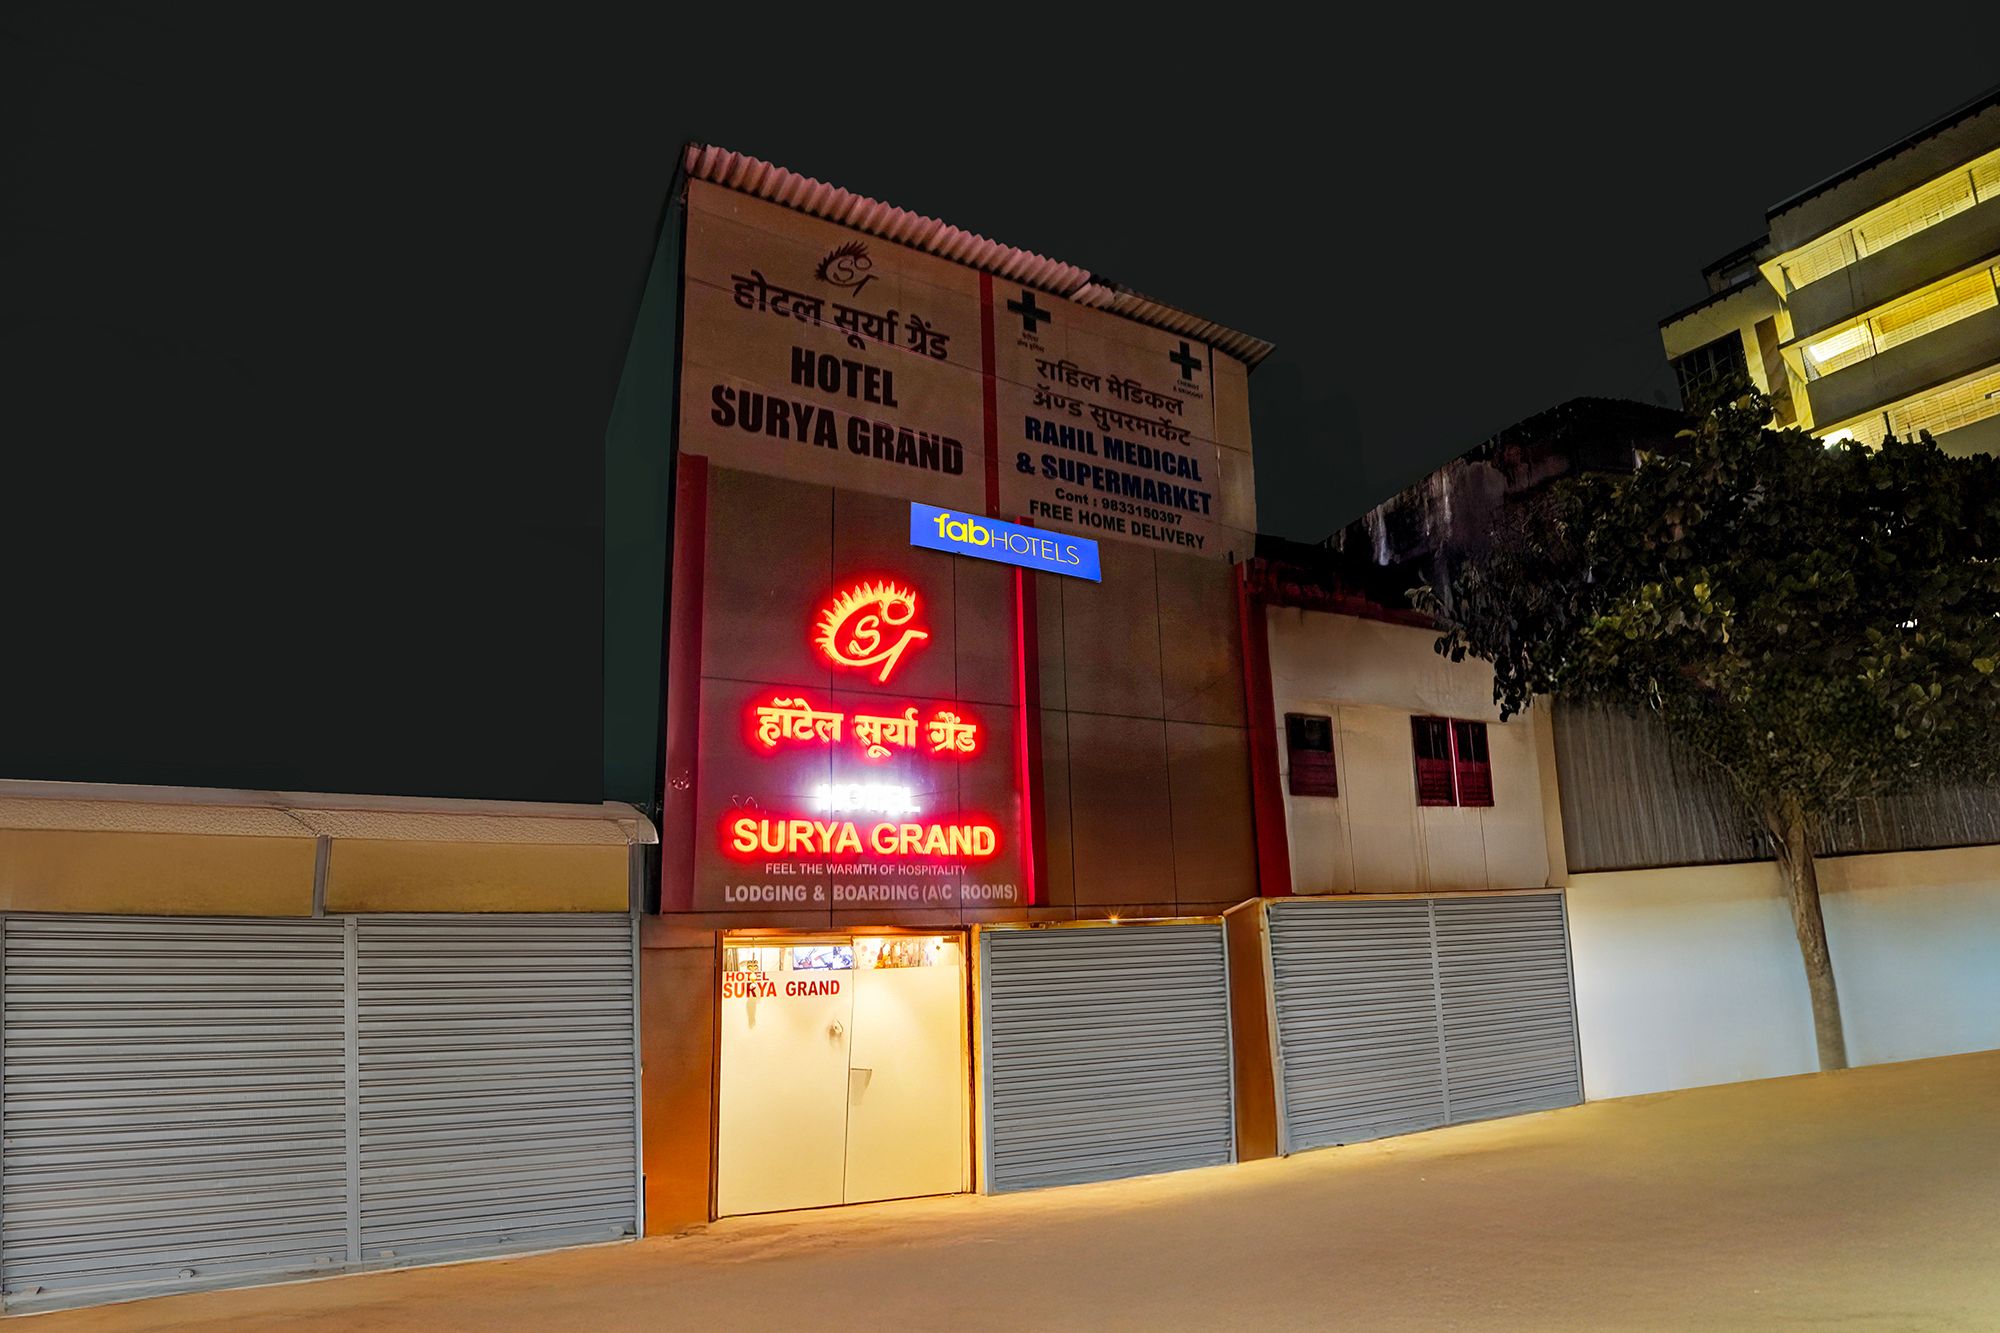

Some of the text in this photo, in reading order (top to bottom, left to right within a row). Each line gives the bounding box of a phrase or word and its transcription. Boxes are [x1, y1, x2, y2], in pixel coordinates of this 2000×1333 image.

[791, 346, 898, 408] HOTEL
[711, 384, 964, 476] SURYA GRAND
[1025, 416, 1202, 482] RAHIL MEDICAL
[1016, 452, 1212, 515] & SUPERMARKET
[1030, 499, 1205, 550] FREE HOME DELIVERY
[1055, 487, 1089, 507] Cont
[1102, 497, 1182, 525] 9833150397
[733, 818, 996, 856] SURYA GRAND
[765, 863, 967, 876] FEEL THE WARMTH OF HOSPITALITY
[725, 885, 807, 902] LODGING
[813, 885, 825, 900] &
[833, 884, 919, 900] BOARDING
[961, 884, 1018, 902] ROOMS)
[723, 980, 840, 998] SURYA GRAND
[726, 971, 769, 981] HOTEL
